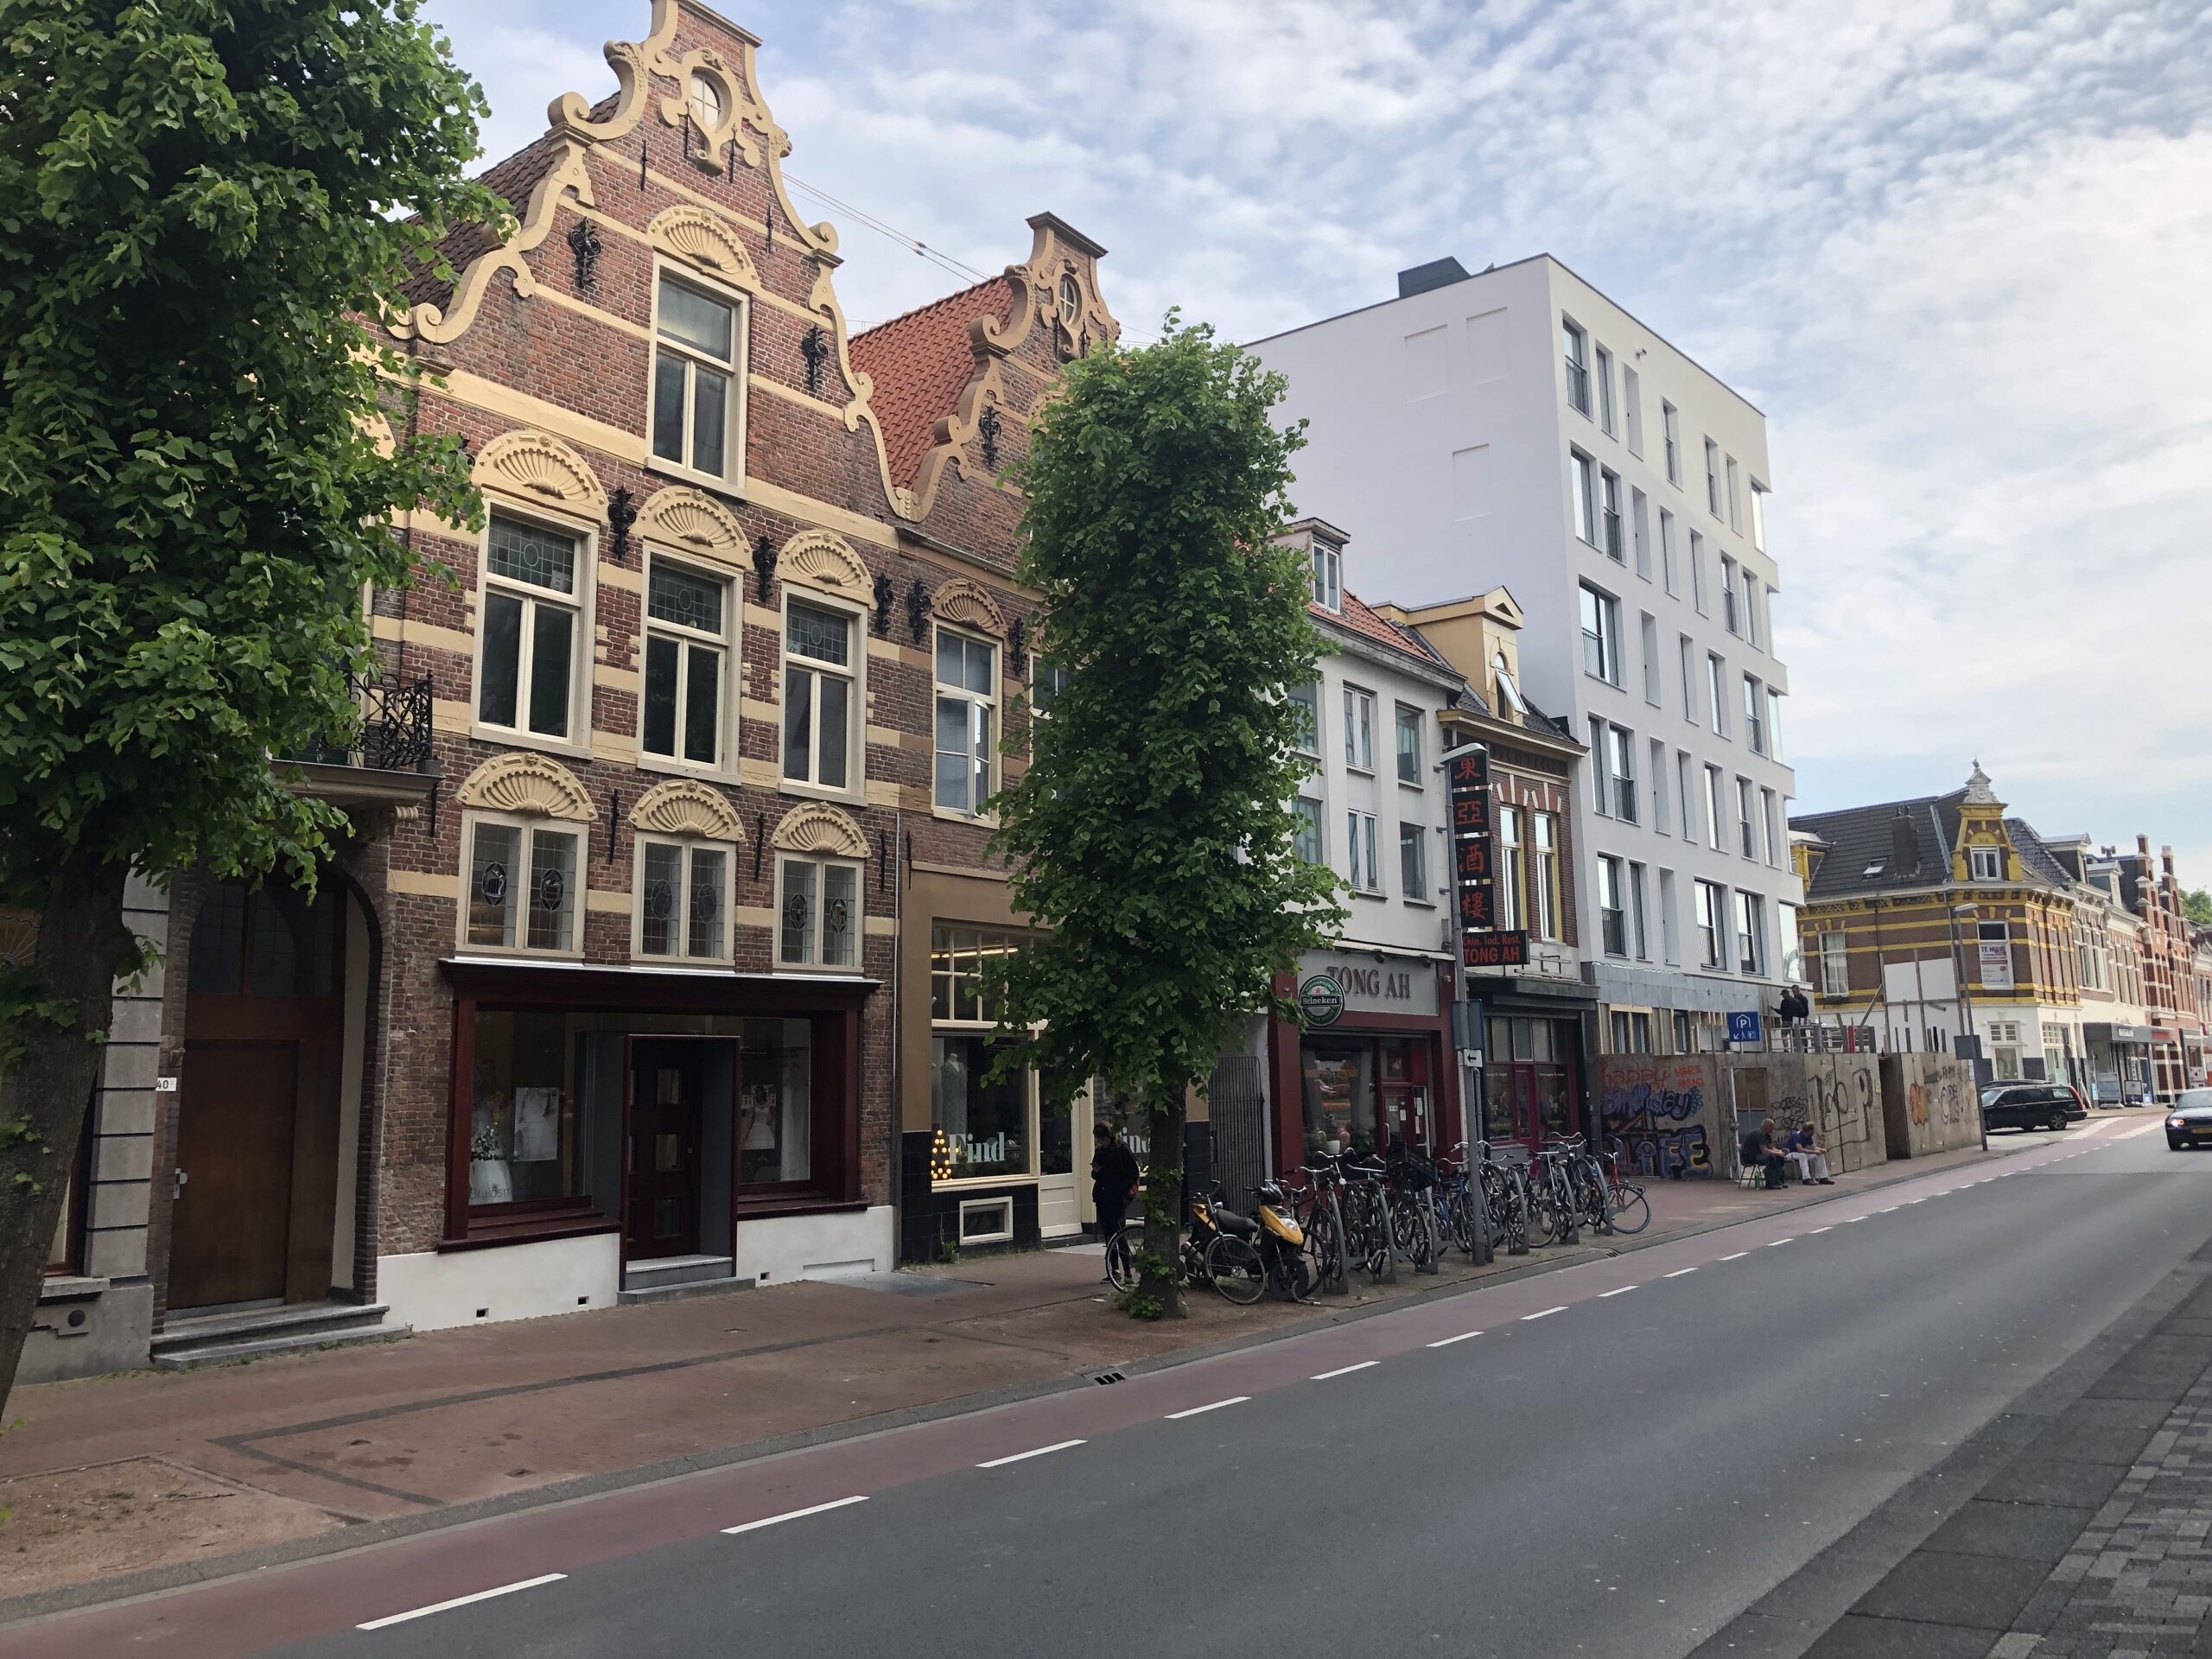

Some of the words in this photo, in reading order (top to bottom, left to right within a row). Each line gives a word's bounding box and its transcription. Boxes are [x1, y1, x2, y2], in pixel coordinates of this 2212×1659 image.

[1484, 934, 1500, 945] Ind.
[1464, 947, 1498, 963] TONG
[1502, 946, 1521, 962] AH
[1326, 966, 1380, 996] TONG
[1384, 972, 1411, 1000] AH
[1302, 996, 1338, 1005] Heineken
[947, 1131, 1007, 1165] Find
